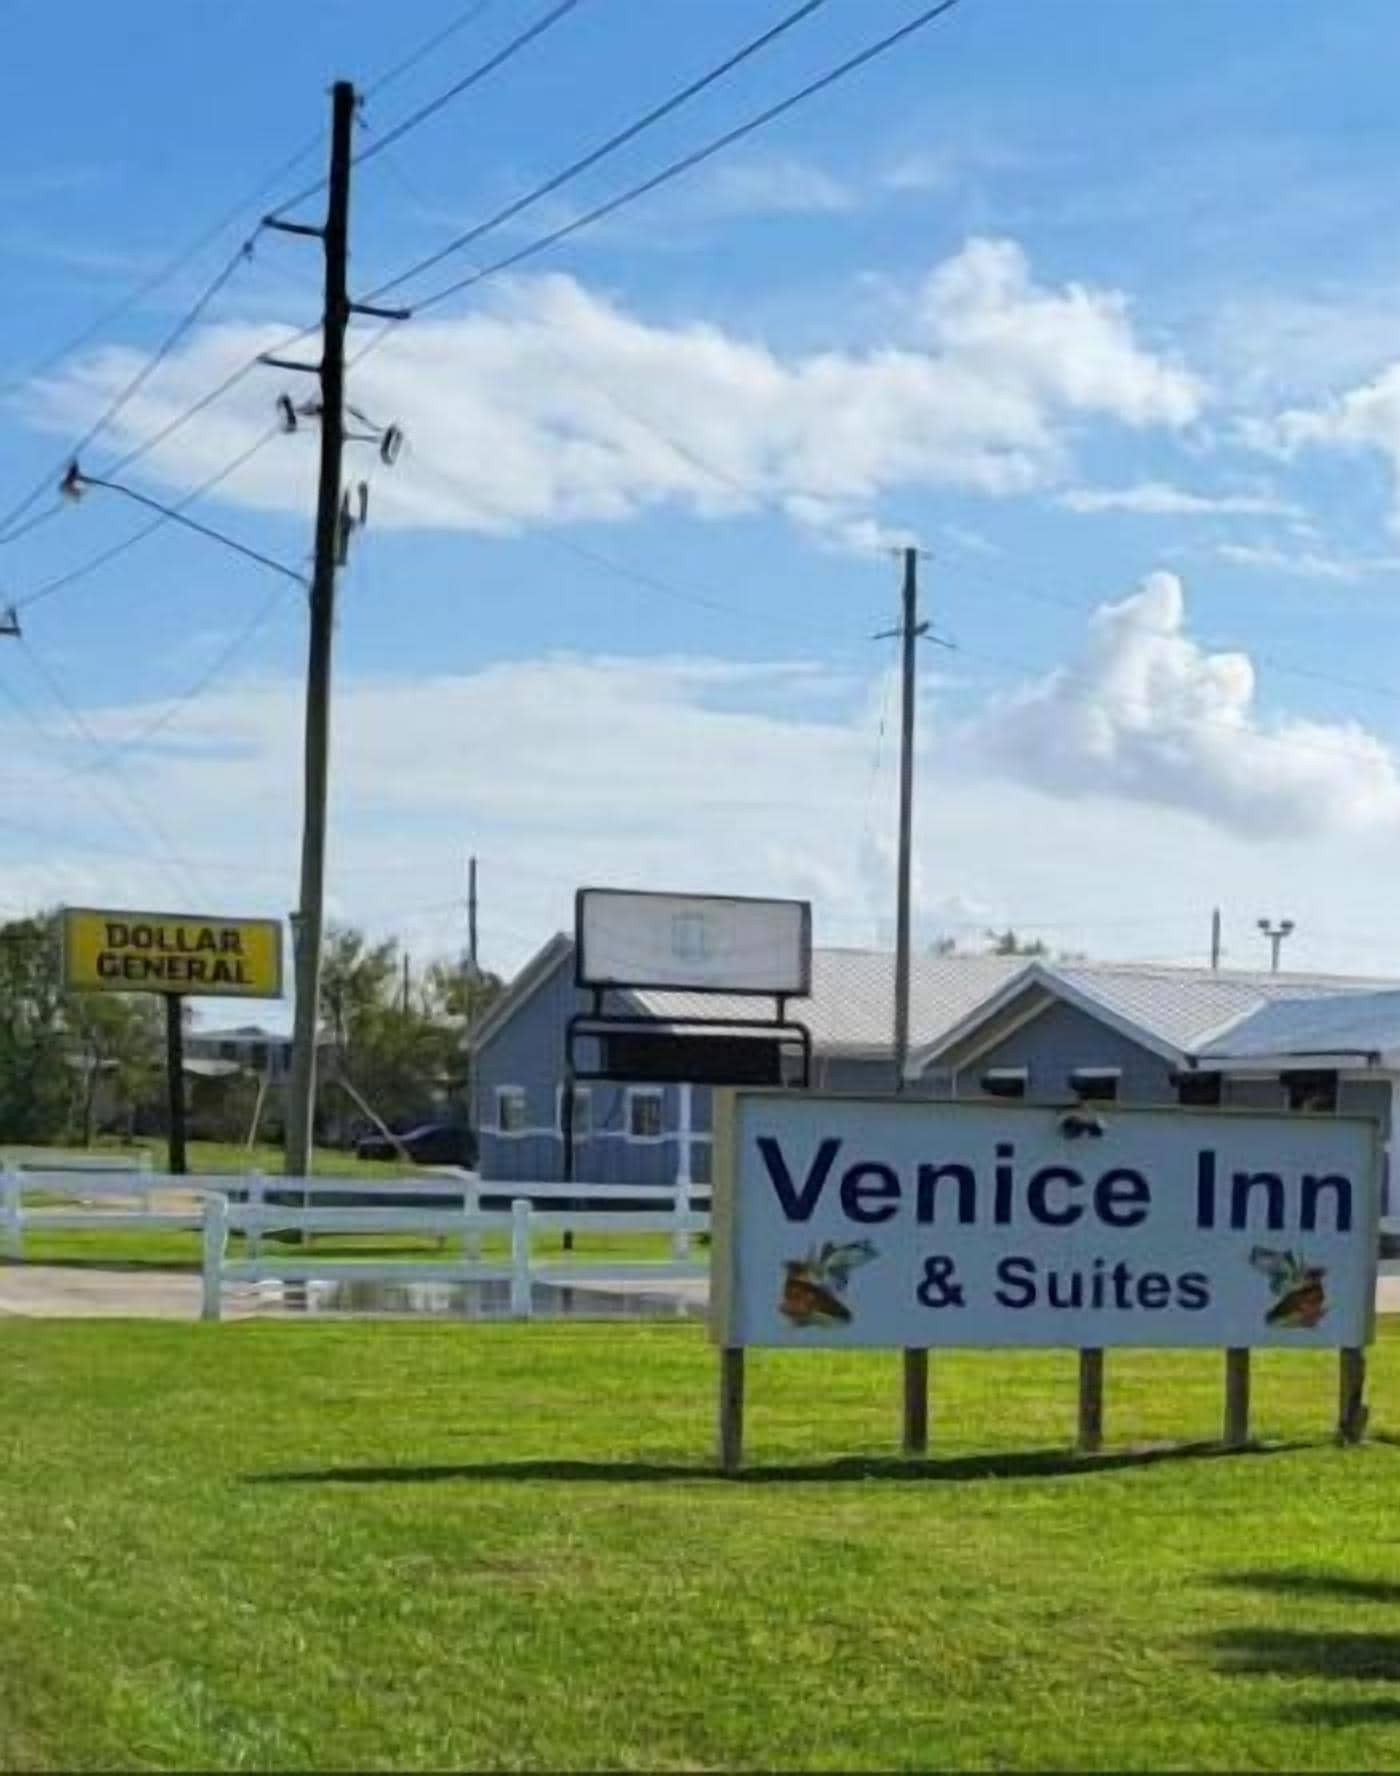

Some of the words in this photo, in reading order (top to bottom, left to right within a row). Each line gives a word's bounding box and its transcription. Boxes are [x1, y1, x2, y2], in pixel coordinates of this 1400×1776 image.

[105, 923, 244, 954] DOLLAR
[97, 951, 256, 984] GENERAL
[756, 1136, 1151, 1229] Venice
[1196, 1148, 1354, 1232] Inn
[916, 1254, 966, 1310] &
[994, 1256, 1211, 1311] Suites
